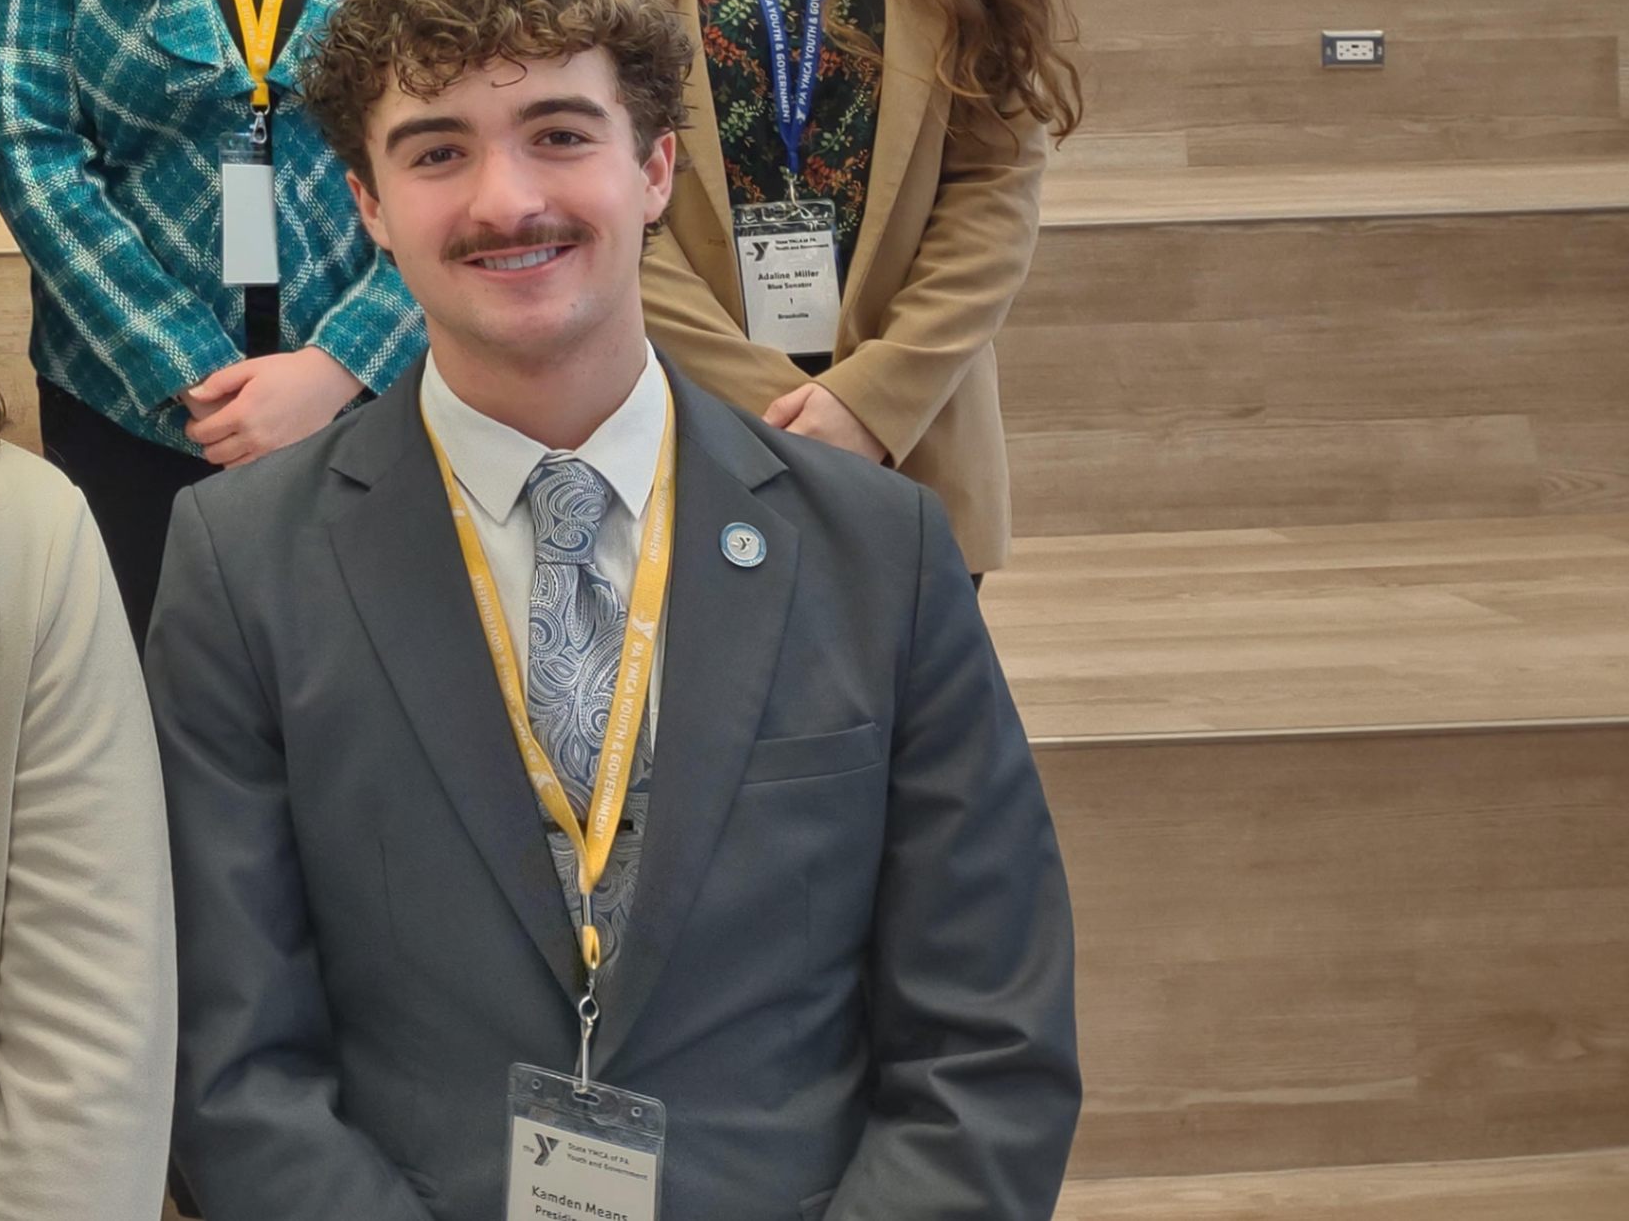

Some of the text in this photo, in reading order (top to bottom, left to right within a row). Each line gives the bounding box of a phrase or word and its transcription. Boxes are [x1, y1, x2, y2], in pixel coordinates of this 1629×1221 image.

[769, 8, 783, 42] YOUTH
[804, 26, 818, 61] YOUTH
[775, 54, 791, 123] GOVERNMENT
[800, 61, 813, 93] YMCA
[797, 92, 808, 106] PA
[758, 269, 819, 281] Adaline Miller
[473, 574, 504, 654] GOVERNMENT
[630, 642, 644, 658] PA
[623, 659, 644, 696] YMCA
[613, 698, 634, 741] YOUTH
[611, 743, 625, 753] &
[594, 753, 622, 839] GOVERNMENT
[567, 1142, 587, 1155] State
[587, 1147, 609, 1161] YMCA
[619, 1157, 630, 1166] PA
[567, 1153, 649, 1181] Youth and Government
[532, 1185, 628, 1221] Kamden Means
